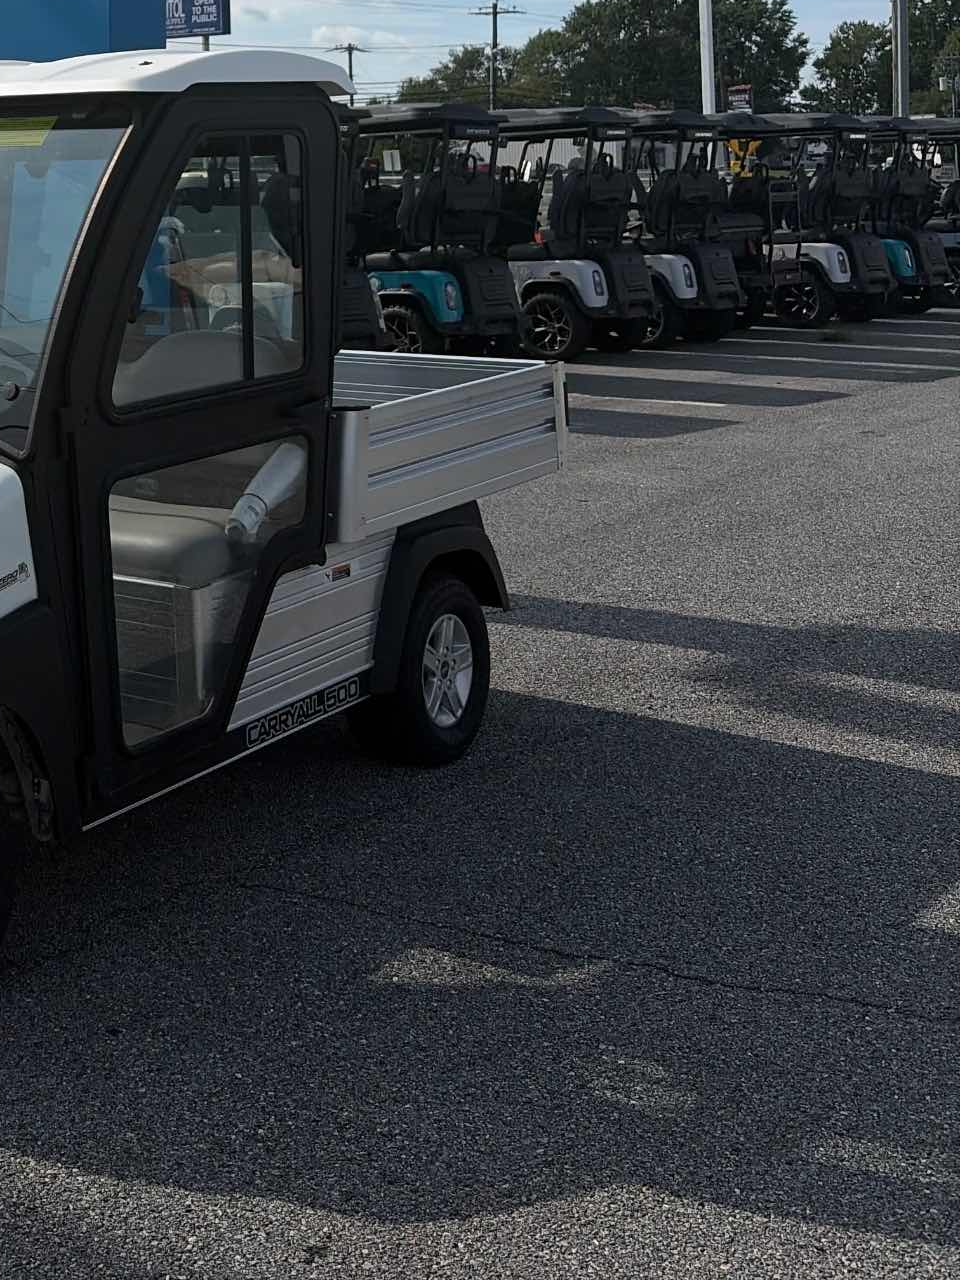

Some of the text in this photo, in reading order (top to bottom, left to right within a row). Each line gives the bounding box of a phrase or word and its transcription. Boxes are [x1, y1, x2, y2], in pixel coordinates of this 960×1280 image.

[192, 5, 217, 15] TO THE
[192, 13, 218, 23] PUBLIC
[246, 677, 360, 748] CARRYALL 500
